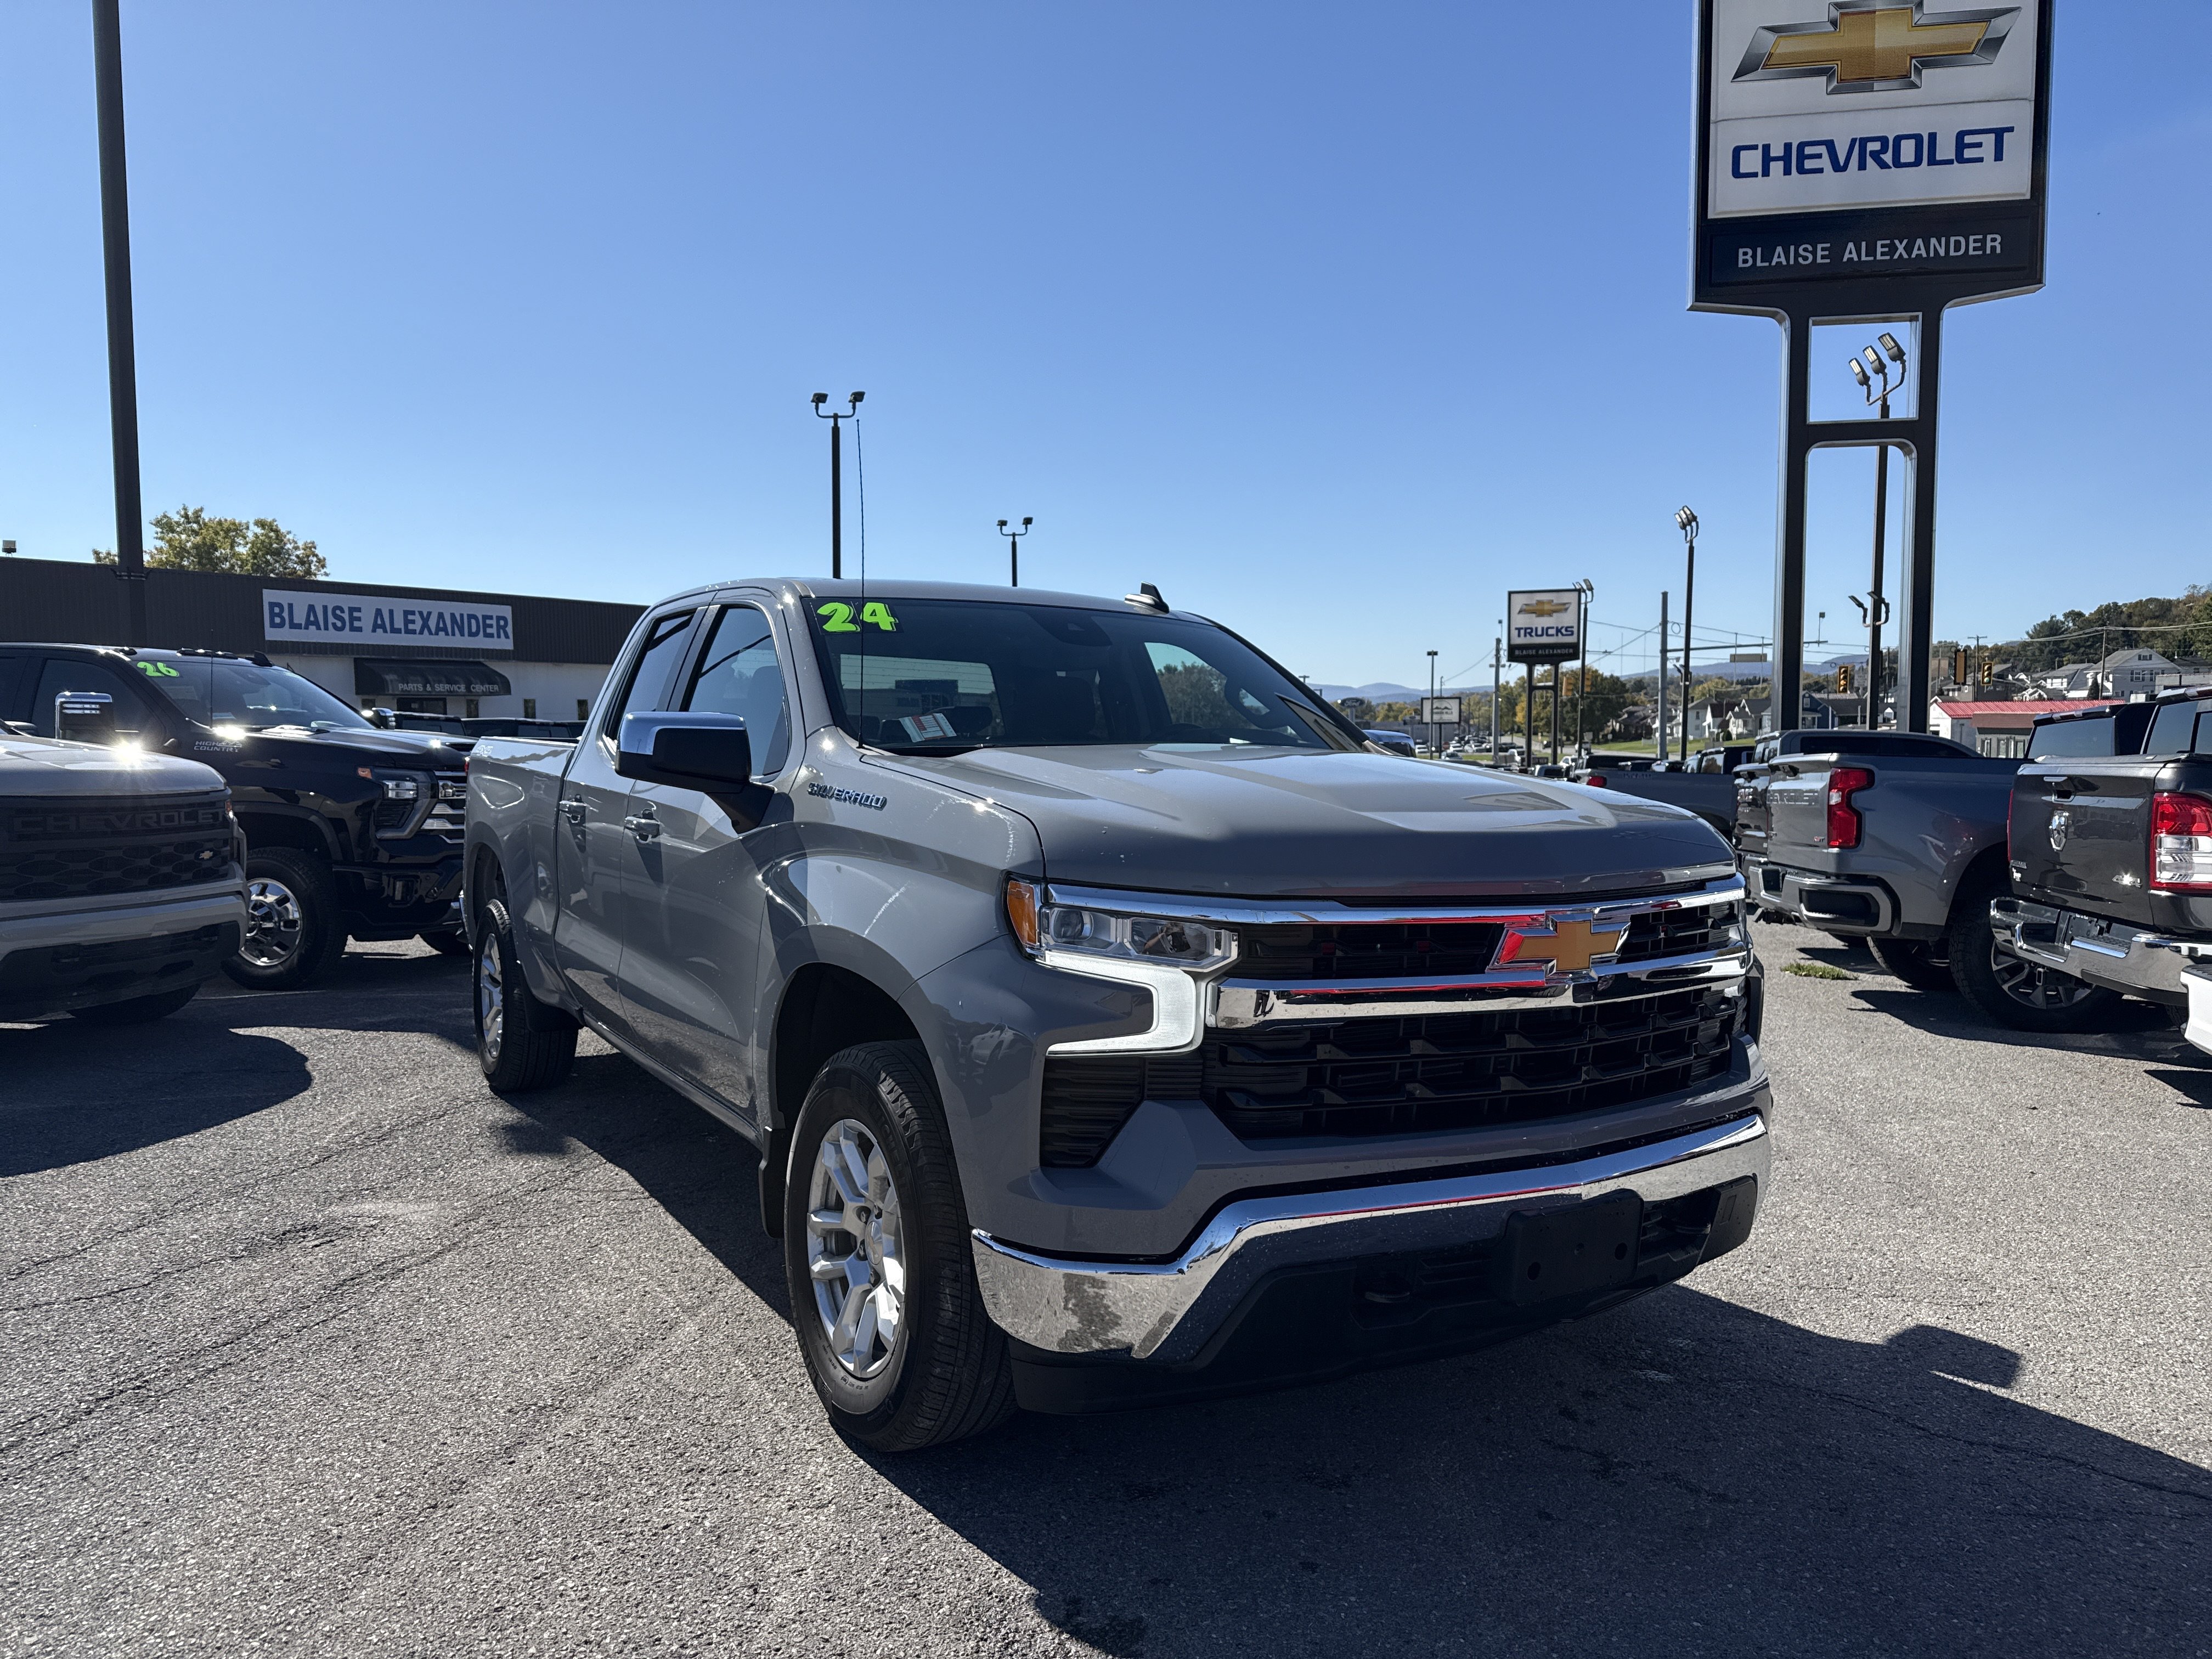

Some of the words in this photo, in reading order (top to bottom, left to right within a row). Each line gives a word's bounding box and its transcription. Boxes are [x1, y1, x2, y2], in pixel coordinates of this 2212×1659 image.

[1731, 126, 2015, 179] CHEVROLET
[1737, 242, 1831, 268] BLAISE
[1842, 234, 2002, 262] ALEXANDER
[267, 601, 363, 633] BLAISE
[371, 607, 510, 640] ALEXANDER
[816, 602, 899, 633] 24
[1515, 625, 1575, 637] TRUCKS
[137, 661, 180, 677] 26
[398, 683, 423, 692] PARTS
[426, 683, 432, 692] &
[434, 684, 466, 692] SERVICE
[470, 684, 499, 692] CENTER
[807, 781, 887, 811] SILVERADO
